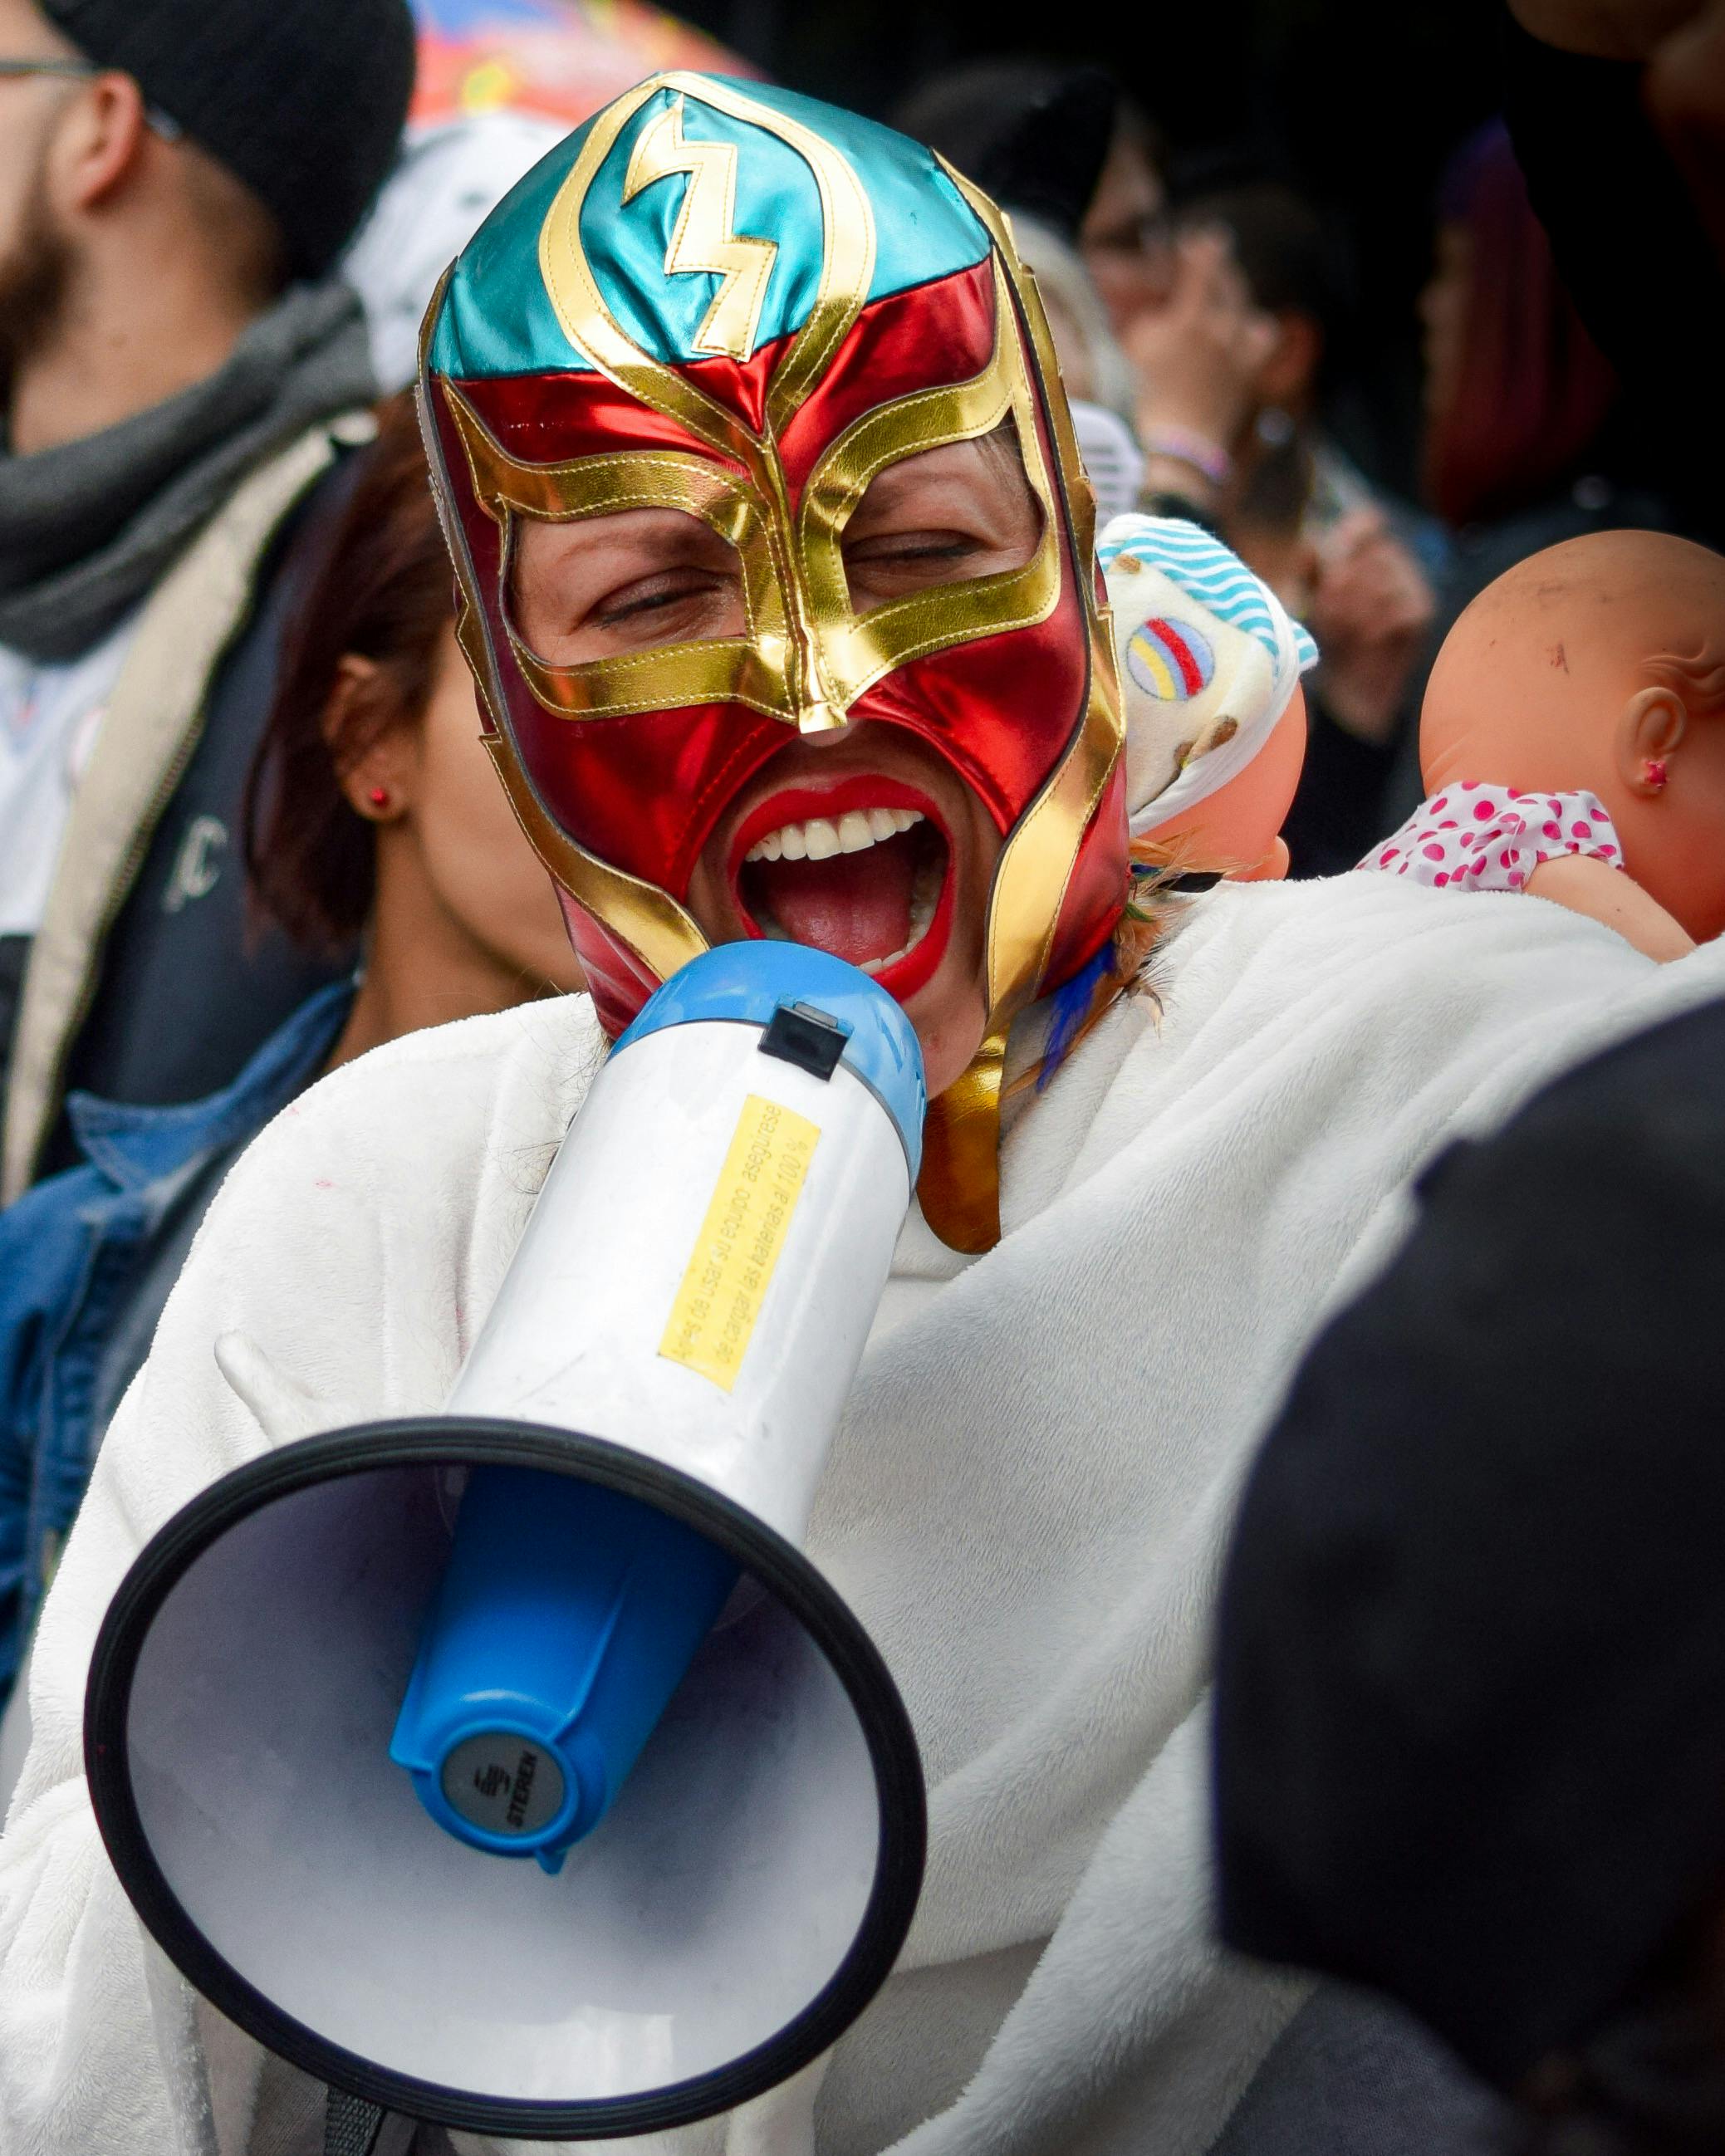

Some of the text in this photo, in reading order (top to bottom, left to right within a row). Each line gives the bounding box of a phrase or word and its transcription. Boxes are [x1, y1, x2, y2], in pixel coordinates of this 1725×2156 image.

[777, 1154, 801, 1187] 100
[772, 1183, 790, 1205] al
[720, 1188, 751, 1239] equipo
[714, 1239, 732, 1262] su
[698, 1260, 723, 1296] usar
[738, 1267, 762, 1293] las
[686, 1297, 711, 1320] de
[723, 1290, 752, 1343] cargar
[713, 1341, 734, 1364] de
[507, 1749, 537, 1827] STEREN
